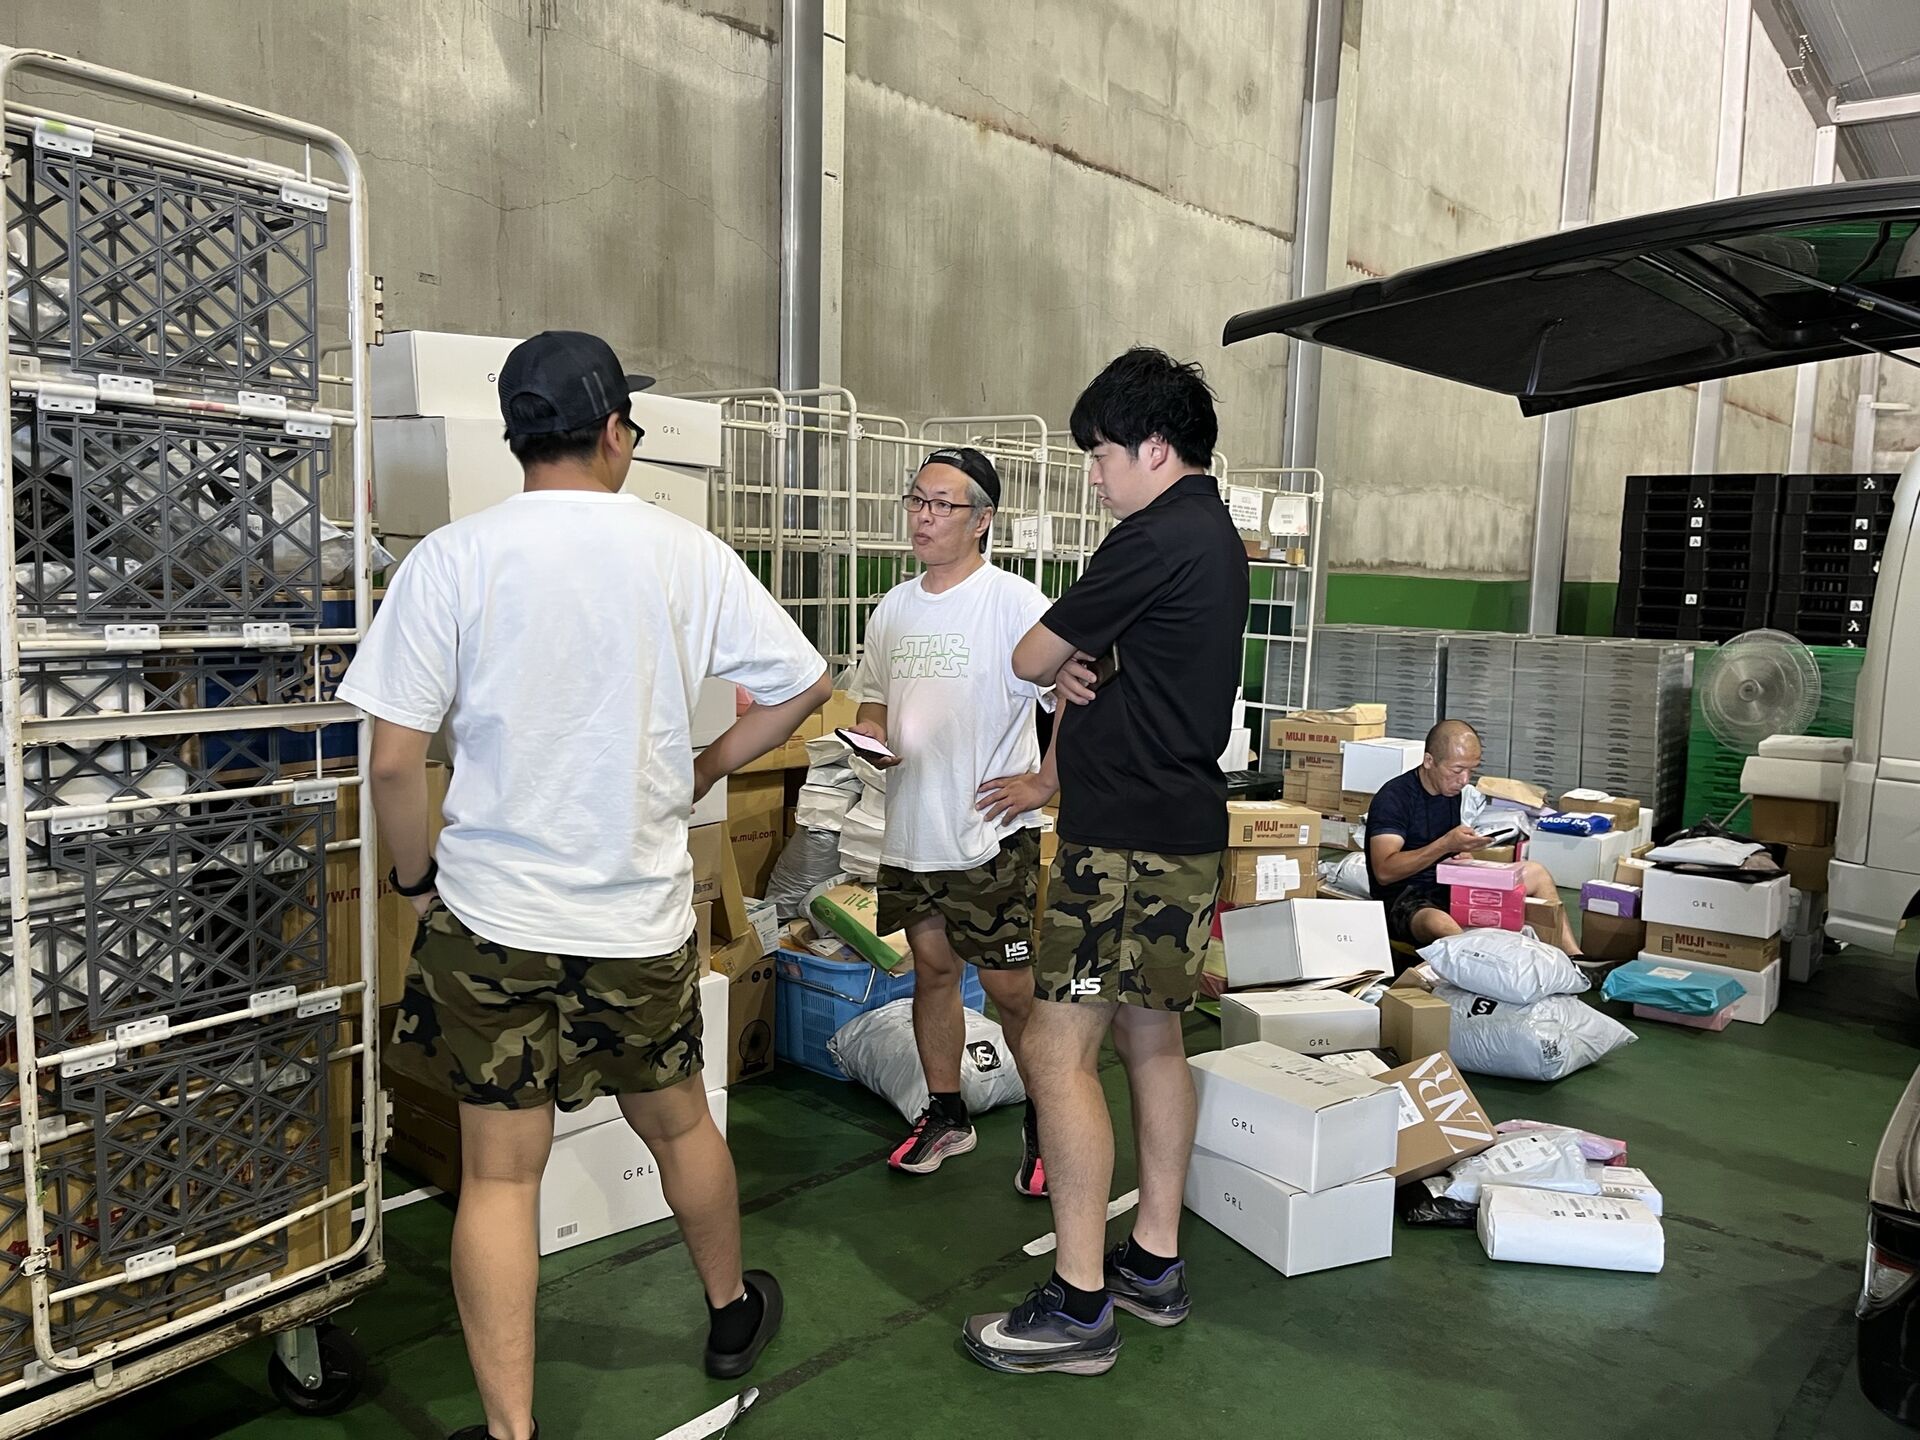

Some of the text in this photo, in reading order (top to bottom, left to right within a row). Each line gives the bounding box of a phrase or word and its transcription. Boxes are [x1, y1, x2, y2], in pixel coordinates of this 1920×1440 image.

[662, 425, 681, 435] GRL
[654, 491, 672, 501] GRL
[890, 633, 970, 657] STAR
[890, 655, 968, 679] WARS
[1285, 731, 1306, 742] MUJI
[1306, 755, 1321, 764] MUJI
[1254, 820, 1279, 832] MUJI
[1691, 900, 1715, 910] GRL
[1336, 934, 1353, 942] GRL
[1675, 933, 1704, 948] MUJI
[1070, 977, 1102, 995] HS
[1309, 1038, 1330, 1047] GRL
[1408, 1052, 1494, 1154] ZARA
[1231, 1117, 1255, 1134] GRL
[623, 1164, 654, 1180] GRL
[1223, 1192, 1243, 1210] GRL
